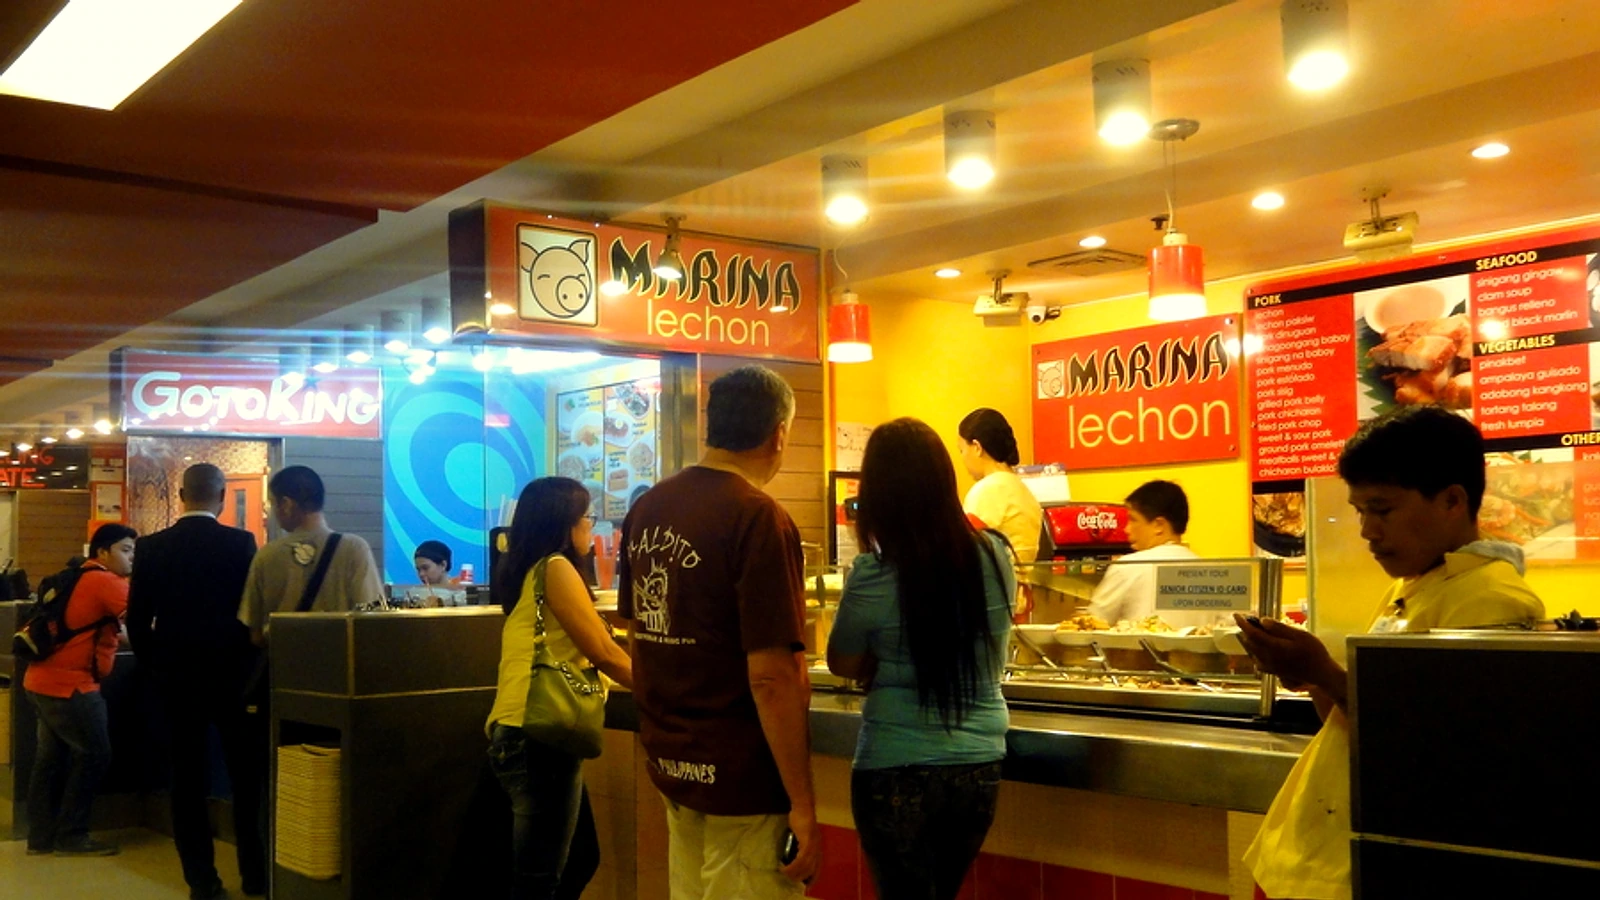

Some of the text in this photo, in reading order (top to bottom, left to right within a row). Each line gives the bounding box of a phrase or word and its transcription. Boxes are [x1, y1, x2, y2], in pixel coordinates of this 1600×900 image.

[1476, 251, 1537, 271] SEAFOOD
[609, 236, 800, 315] MARINA
[1476, 274, 1520, 287] sinigang
[1255, 294, 1282, 308] PORK
[1477, 288, 1532, 302] clam soup
[1477, 299, 1556, 316] bangus relleno
[647, 298, 770, 347] lechon
[1285, 315, 1315, 328] paksiw
[1511, 315, 1543, 327] black
[1543, 310, 1579, 324] marlin
[1275, 328, 1317, 338] dinuguan
[1320, 334, 1351, 345] baboy
[1479, 335, 1555, 354] VEGETABLES
[1292, 351, 1304, 360] na
[1305, 348, 1335, 359] baboy
[1067, 331, 1230, 398] MARINA
[1256, 363, 1313, 377] pork menudo
[1479, 356, 1526, 371] pinakbet
[1479, 367, 1581, 385] ampalaya guisado
[1256, 379, 1275, 389] pork
[1256, 390, 1275, 400] pork
[1480, 383, 1588, 400] adobong kangkong
[1257, 394, 1326, 410] grilled pork belly
[1481, 402, 1557, 416] tortang talong
[1257, 408, 1322, 421] pork chicharon
[1068, 396, 1231, 449] lechon
[1257, 418, 1322, 432] fried pork chop
[1481, 419, 1544, 432] fresh lumpia
[1258, 429, 1332, 444] sweet & sour pork
[1258, 444, 1289, 456] ground
[1290, 443, 1310, 453] pork
[1259, 455, 1300, 466] meatballs
[1301, 453, 1327, 463] sweet
[1259, 467, 1302, 478] chicharon
[1177, 568, 1229, 578] PRESENT YOUR
[1160, 585, 1247, 595] SENIOR CITIZEN ID CARD
[1172, 599, 1232, 608] UPON ORDERING
[657, 757, 716, 785] PHILIPPINES
